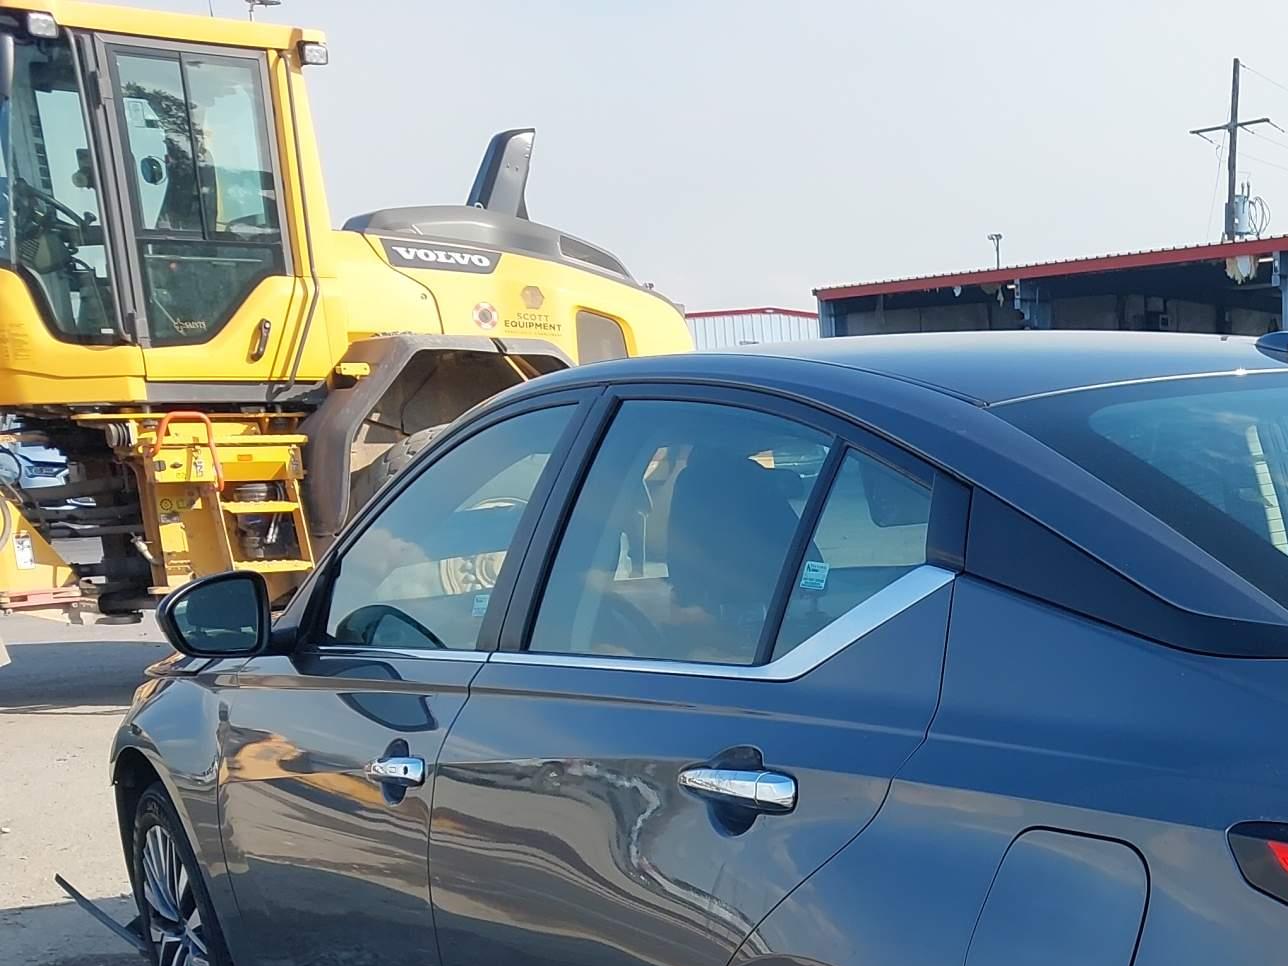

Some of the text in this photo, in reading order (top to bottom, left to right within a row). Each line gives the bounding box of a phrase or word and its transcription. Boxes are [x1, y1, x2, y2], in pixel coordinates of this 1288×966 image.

[392, 246, 490, 267] VOLVO
[516, 313, 549, 322] SCOTT
[504, 320, 562, 332] EQUIPMENT
